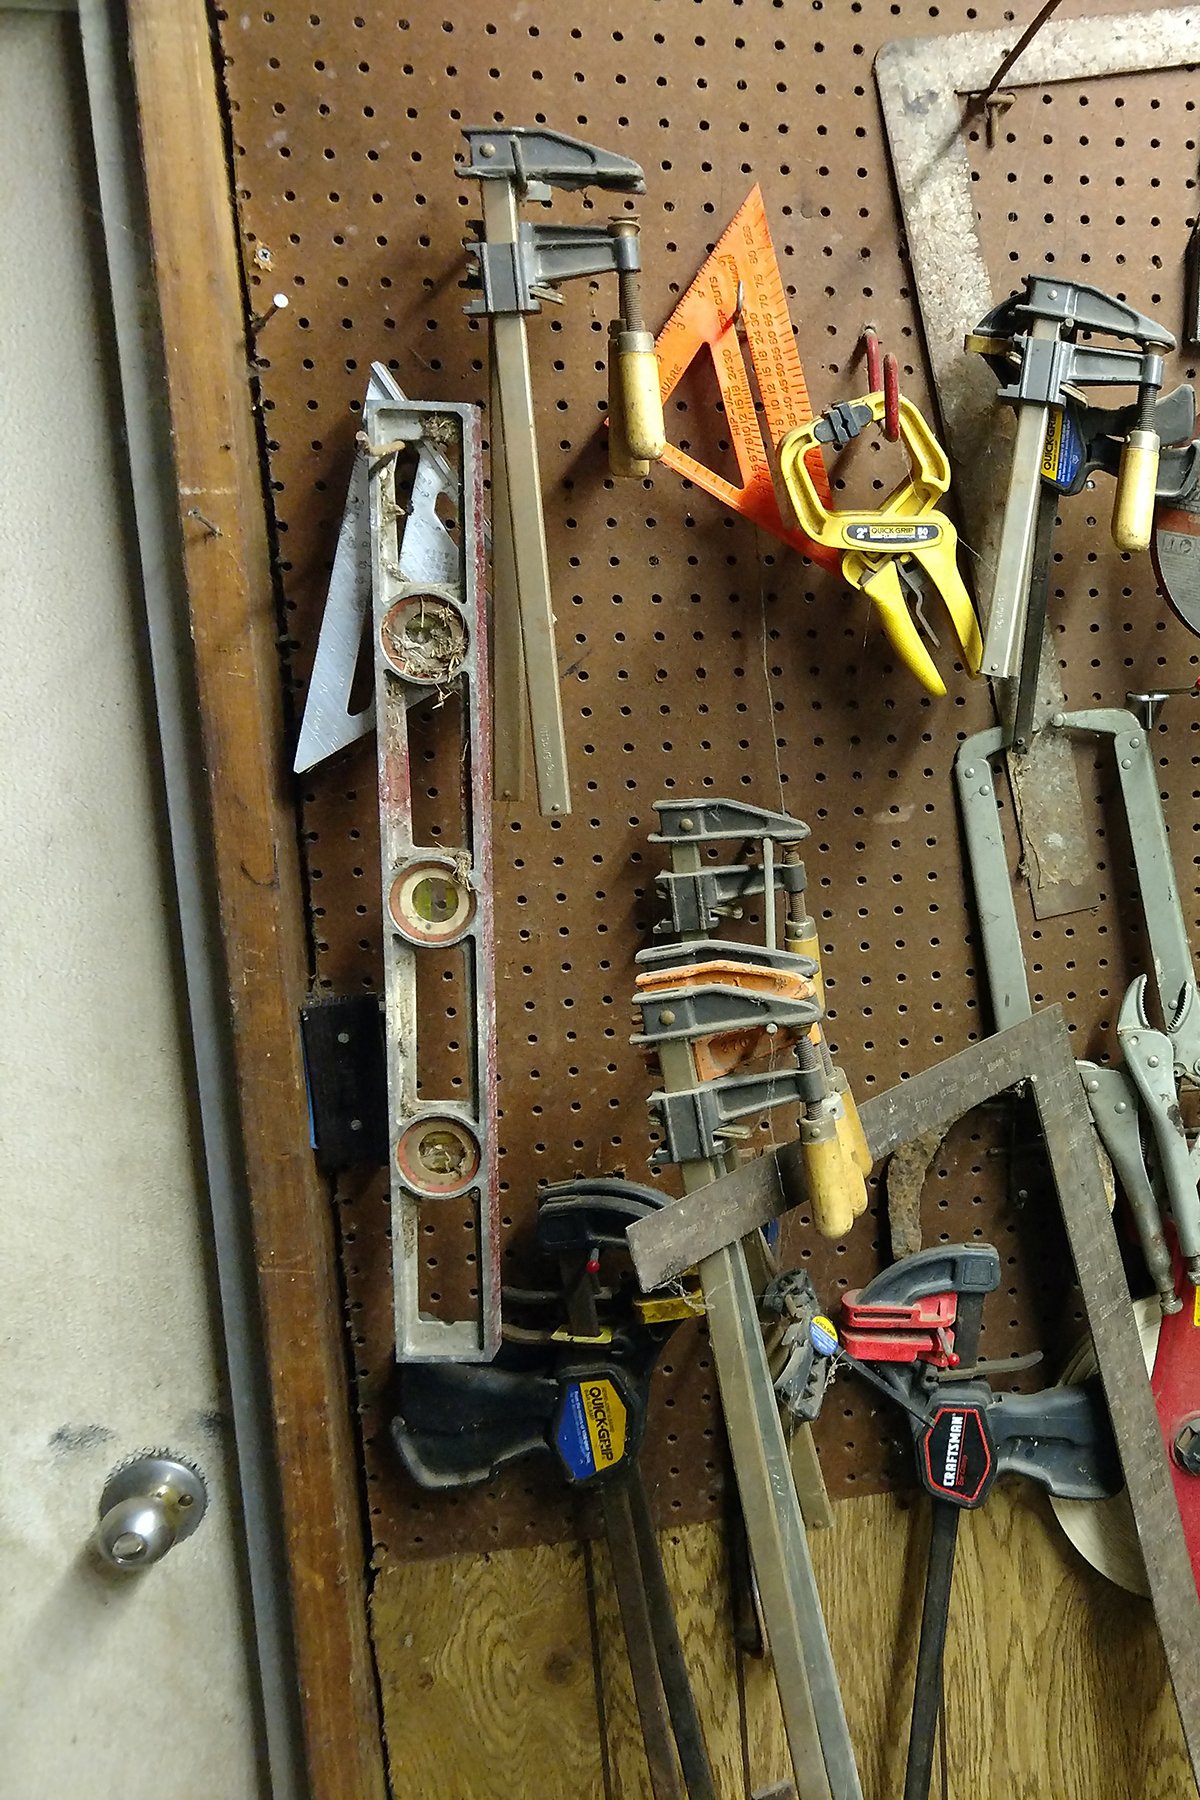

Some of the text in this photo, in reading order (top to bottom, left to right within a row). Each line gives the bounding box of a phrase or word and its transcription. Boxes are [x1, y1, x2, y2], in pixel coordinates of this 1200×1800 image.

[754, 274, 764, 289] 75
[708, 276, 723, 306] CUTS
[759, 294, 769, 309] 70
[749, 312, 760, 327] 30
[722, 349, 733, 364] 30
[758, 350, 768, 361] 18
[771, 347, 782, 361] 55
[762, 366, 772, 377] 15
[775, 363, 786, 377] 50
[766, 383, 776, 394] 12
[779, 379, 790, 394] 45
[734, 398, 744, 409] 15
[770, 399, 780, 410] 10
[783, 396, 793, 411] 40
[738, 412, 748, 424] 12
[786, 412, 798, 427] 35
[943, 1416, 964, 1487] CRAFTSMAN
